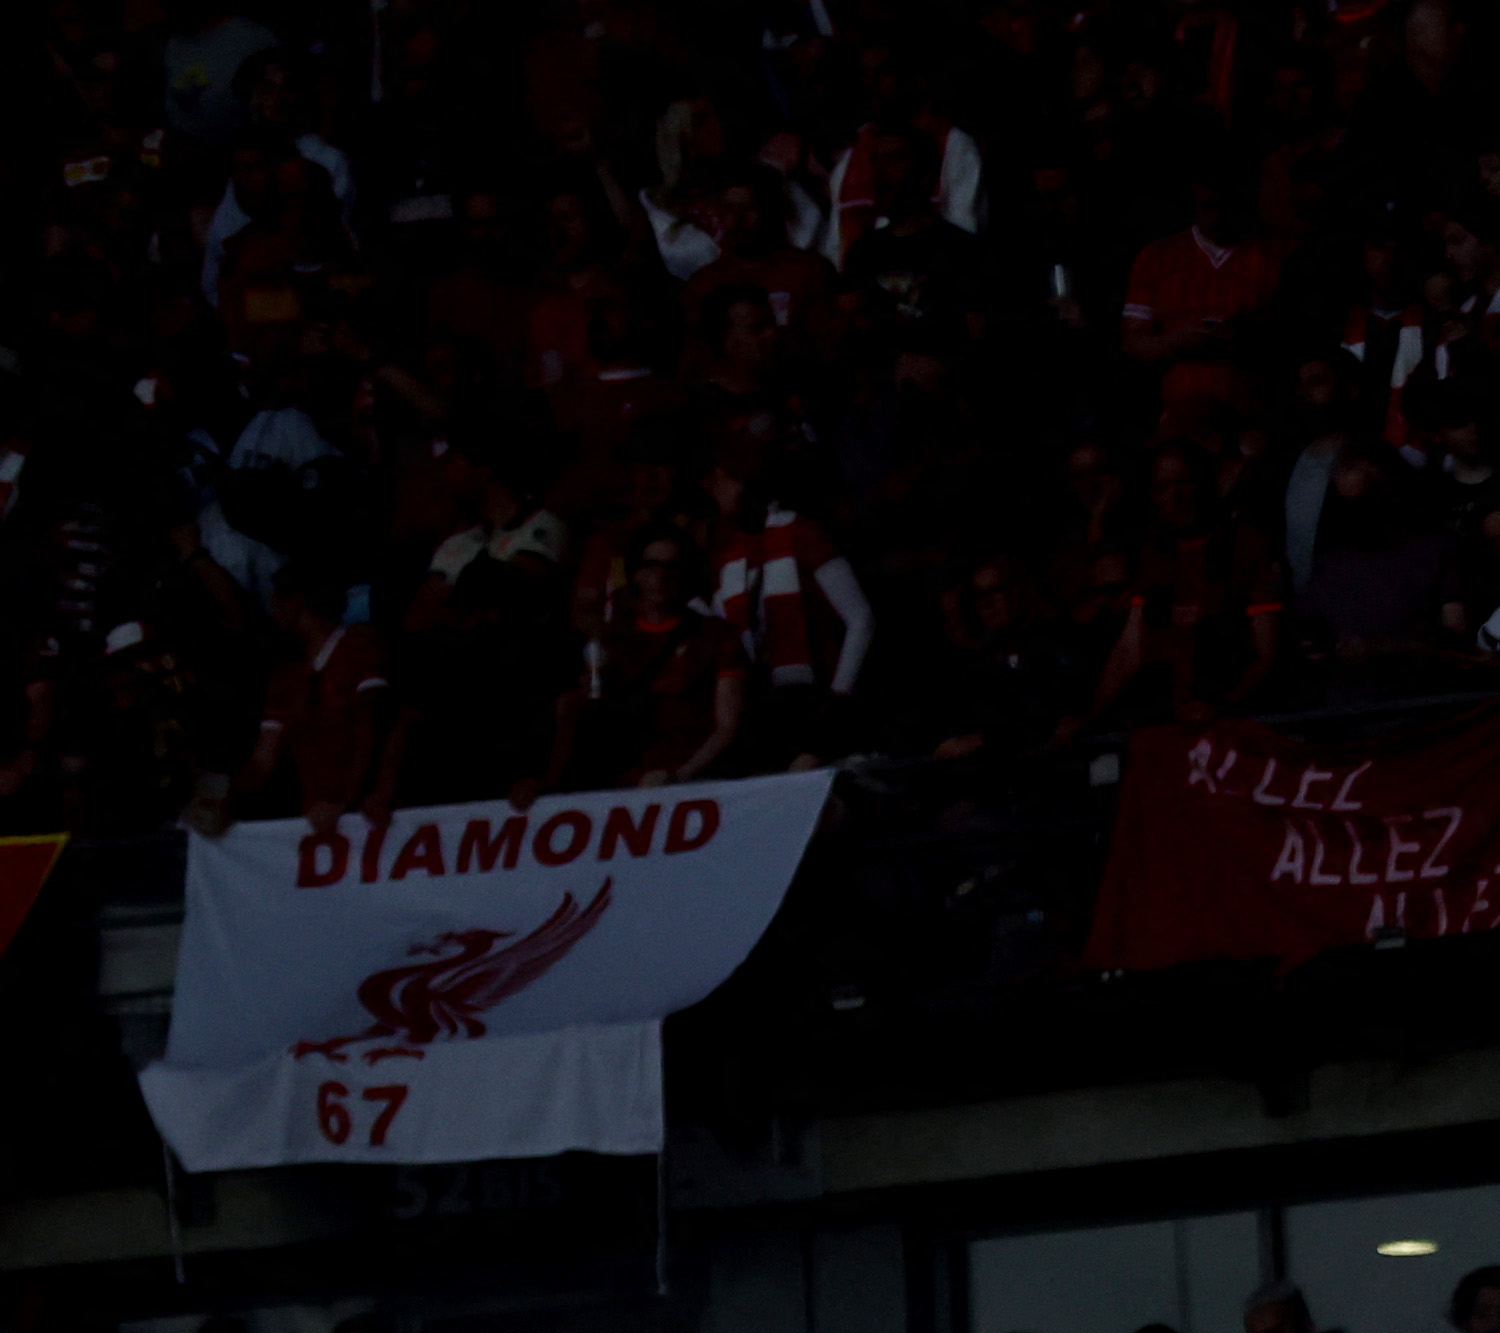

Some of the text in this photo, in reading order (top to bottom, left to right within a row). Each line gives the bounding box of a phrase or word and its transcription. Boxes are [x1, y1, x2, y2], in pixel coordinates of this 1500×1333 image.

[296, 799, 721, 889] DIAMOND
[1271, 805, 1464, 886] ALLEZ
[318, 1081, 409, 1147] 67
